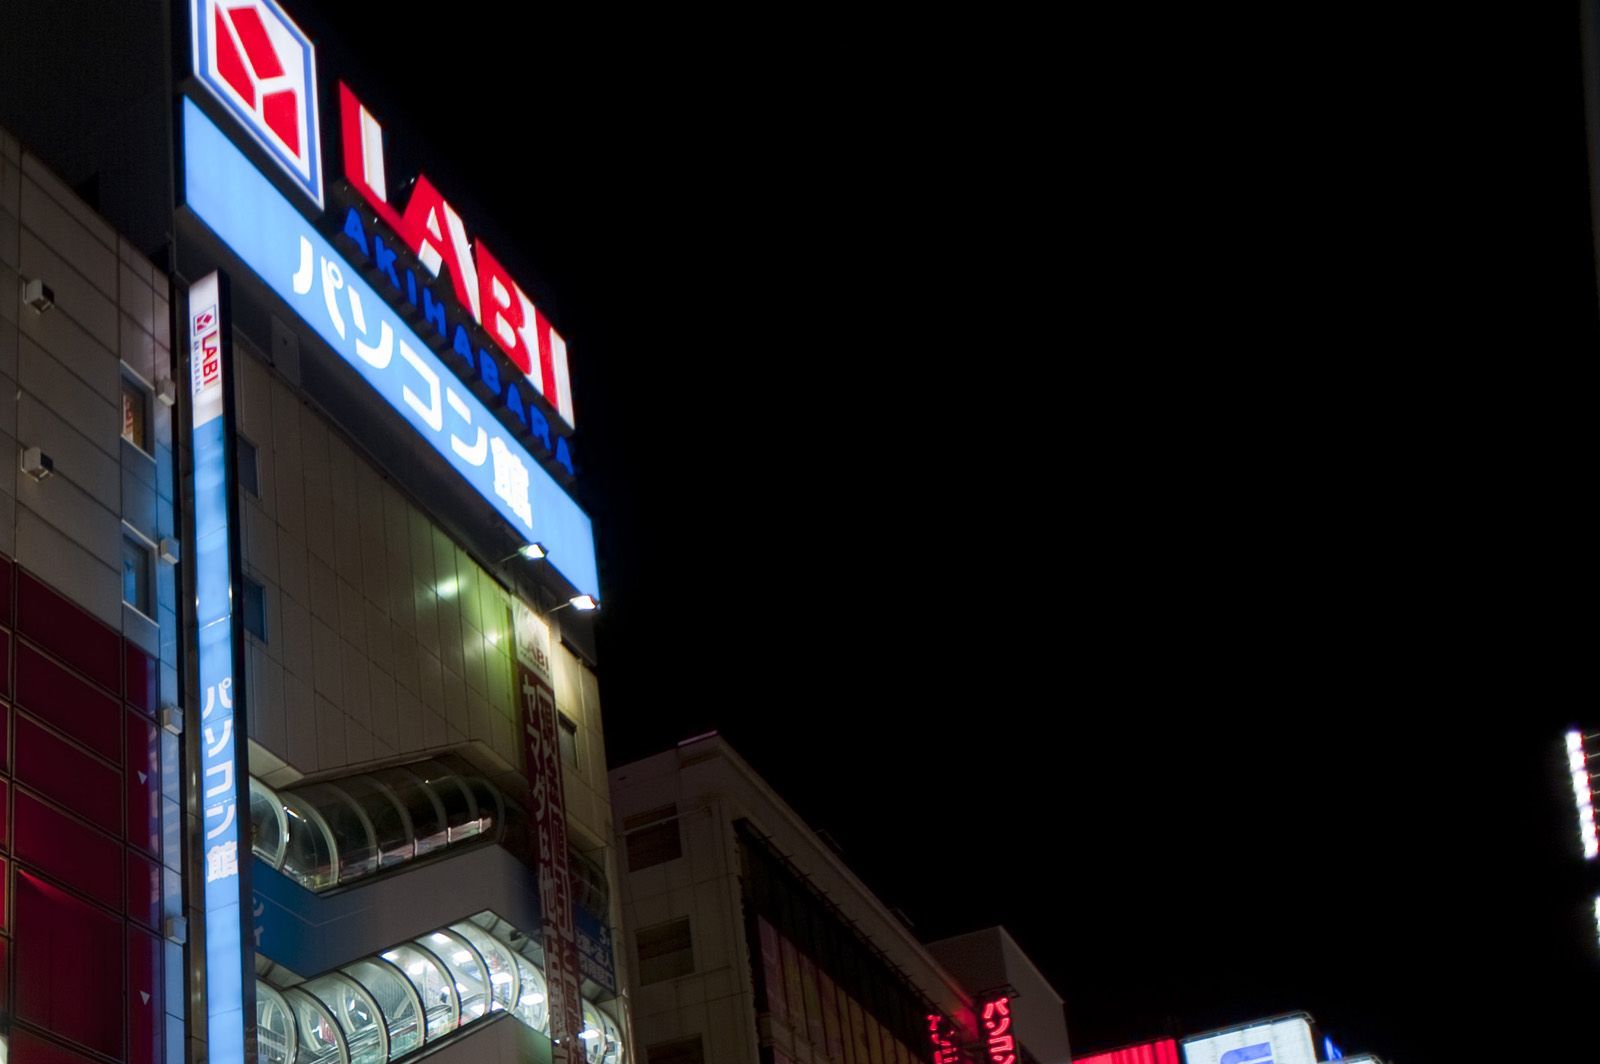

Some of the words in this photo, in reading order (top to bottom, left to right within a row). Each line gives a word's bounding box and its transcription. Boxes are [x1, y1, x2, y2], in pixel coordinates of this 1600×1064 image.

[200, 330, 219, 387] LABI
[293, 235, 533, 529] パソコン館
[339, 80, 576, 431] LABI
[343, 206, 575, 476] AKIHABARA
[202, 680, 240, 885] パソコン館
